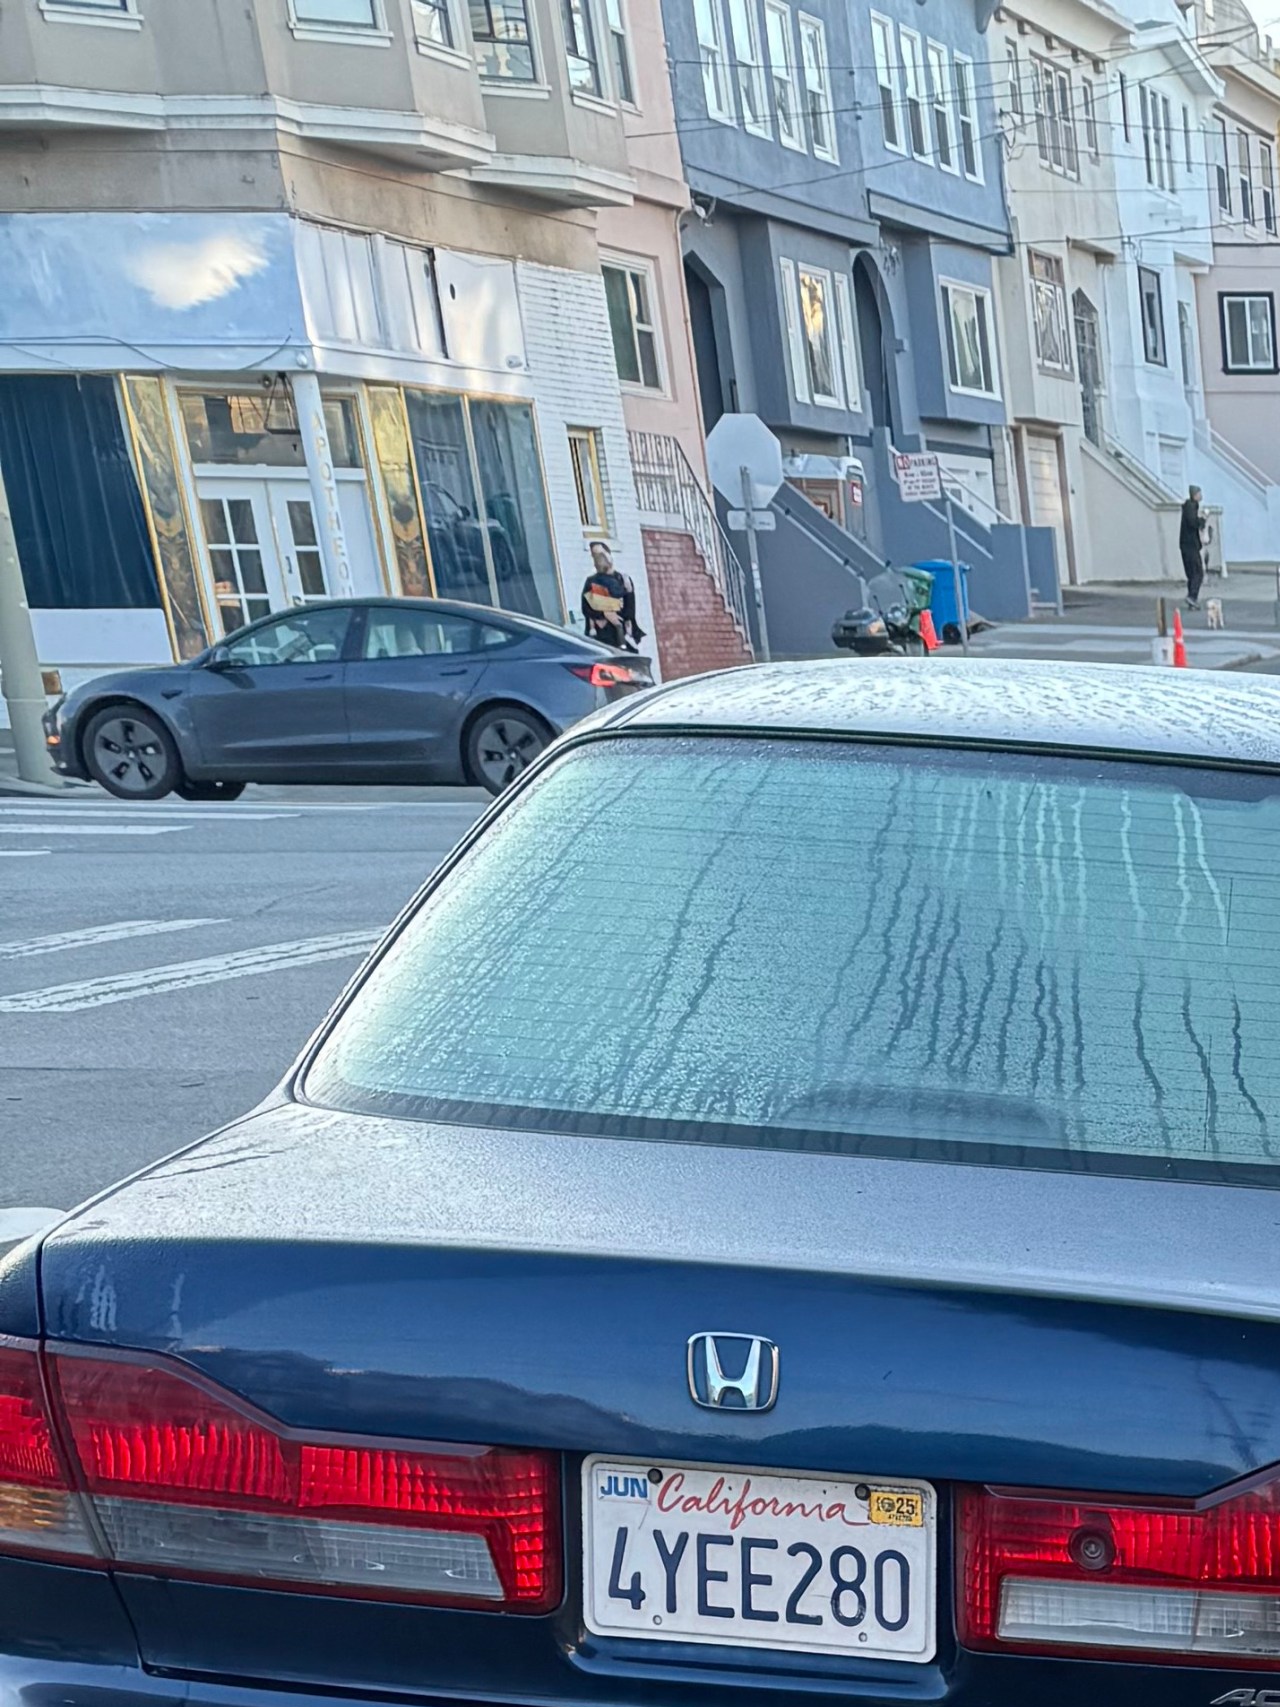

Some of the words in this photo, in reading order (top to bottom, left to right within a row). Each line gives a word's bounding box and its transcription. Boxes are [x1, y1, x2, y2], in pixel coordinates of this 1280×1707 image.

[600, 1475, 649, 1499] JUN
[656, 1472, 871, 1531] California
[896, 1497, 915, 1516] 25
[608, 1526, 912, 1632] 4YEE280
